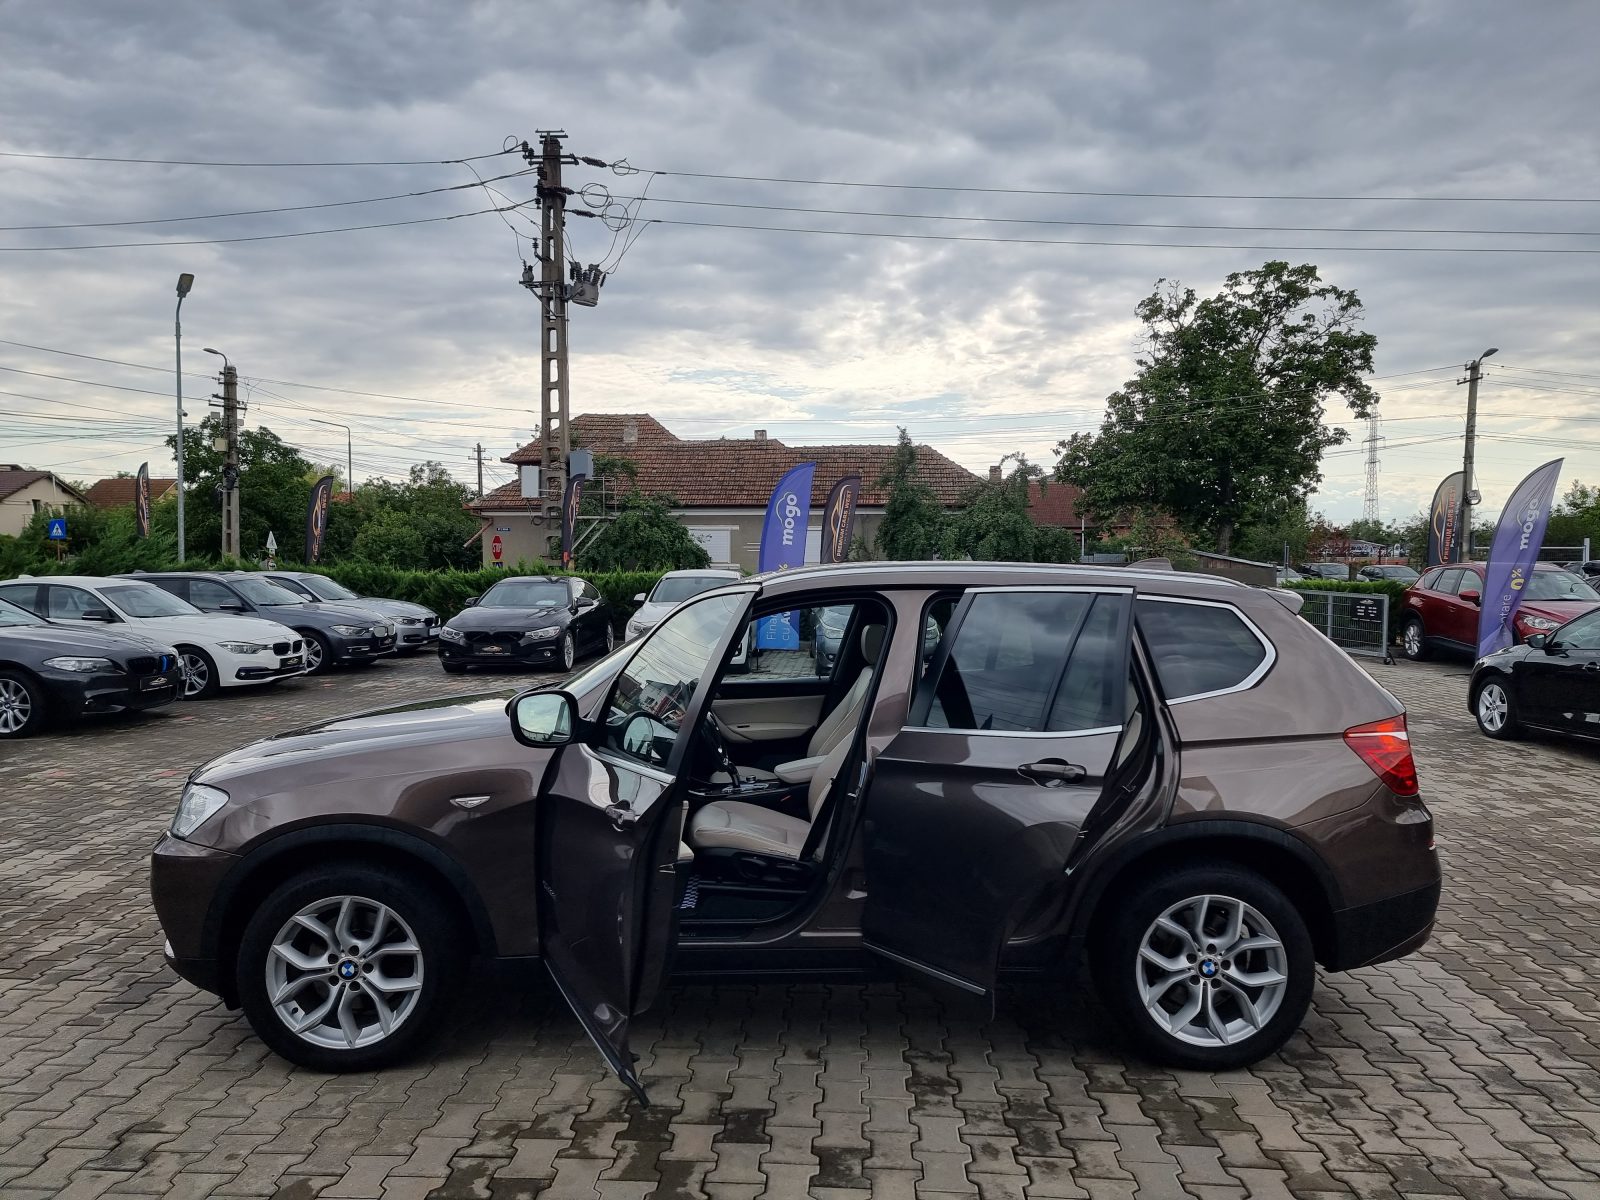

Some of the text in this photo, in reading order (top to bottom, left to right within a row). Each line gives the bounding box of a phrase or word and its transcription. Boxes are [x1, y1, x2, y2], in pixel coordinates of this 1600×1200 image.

[782, 494, 800, 546] mogo
[837, 528, 845, 557] PREMIUM
[844, 490, 852, 509] WEST
[1519, 499, 1540, 550] mogo
[1510, 568, 1525, 591] 0%
[781, 611, 790, 640] cu Av
